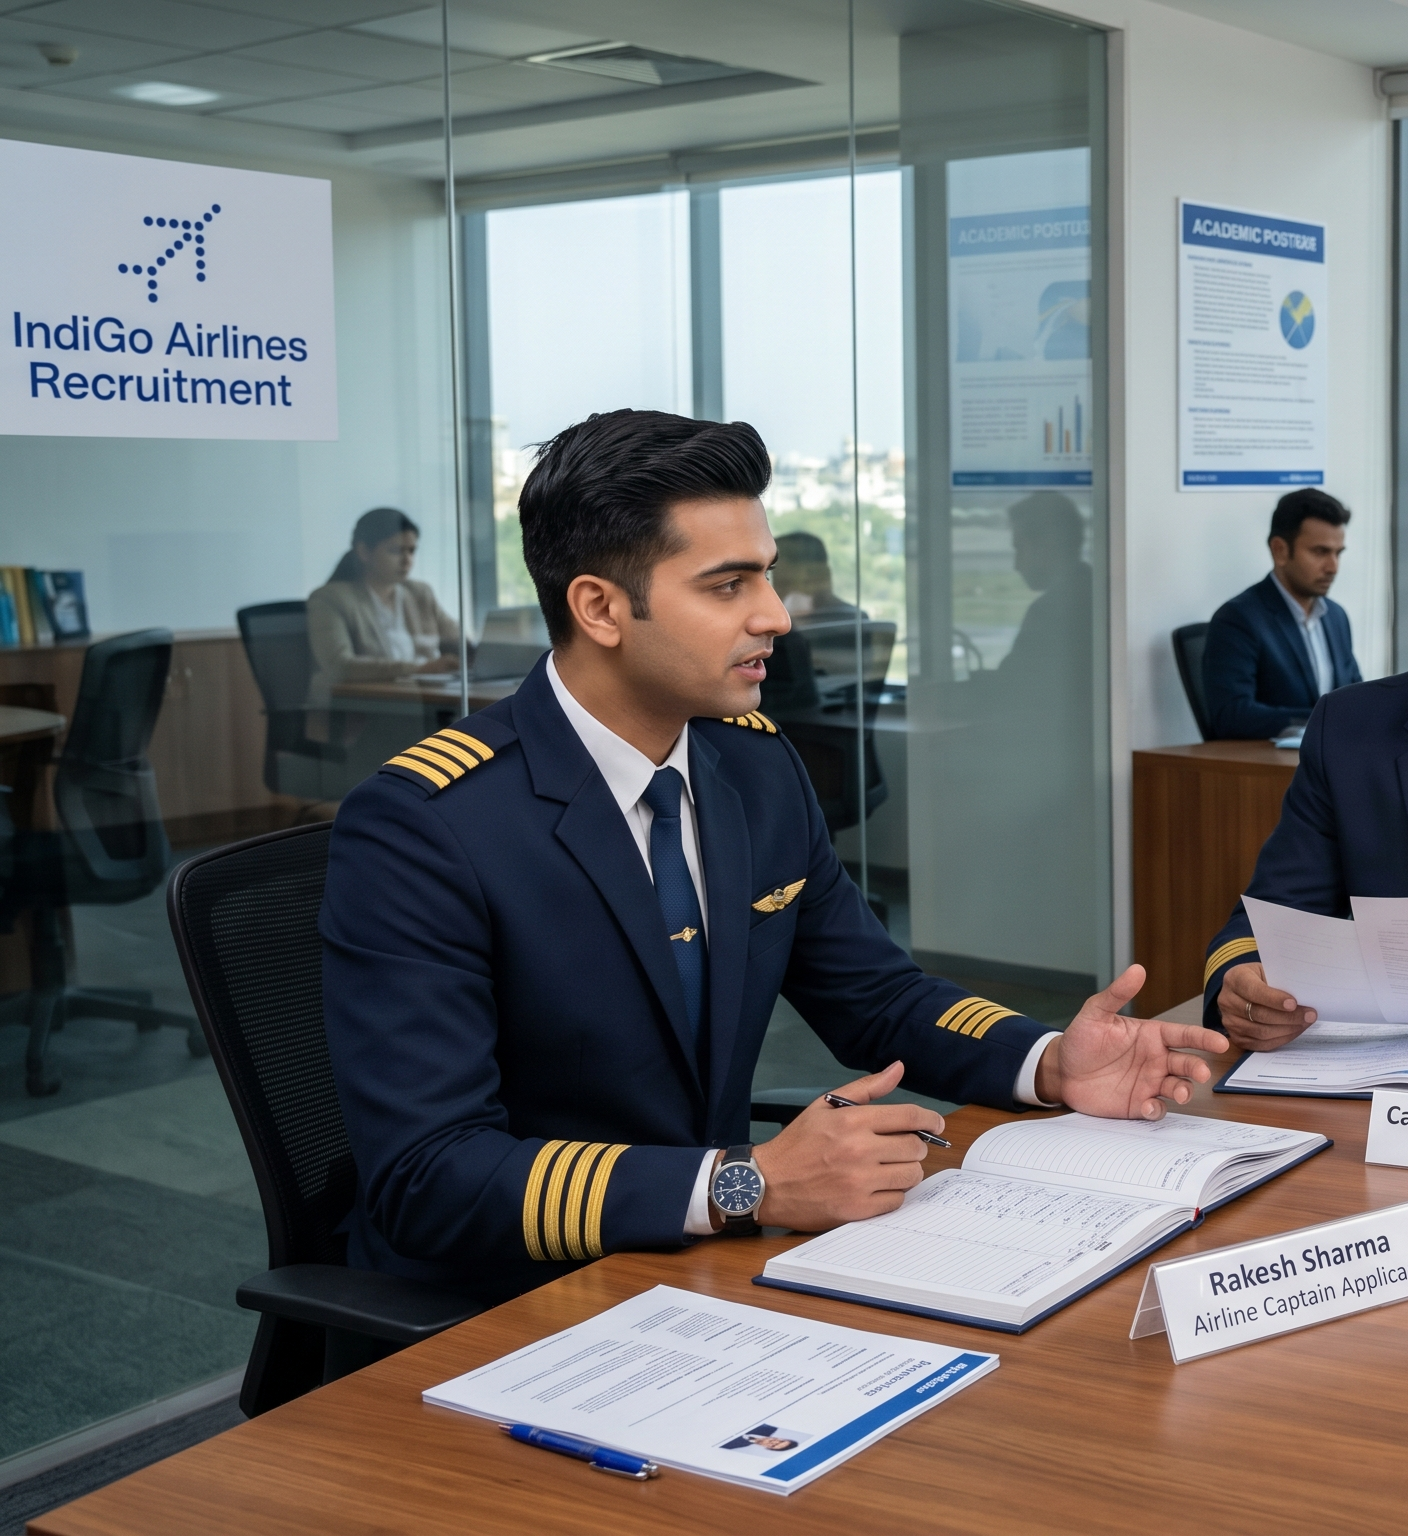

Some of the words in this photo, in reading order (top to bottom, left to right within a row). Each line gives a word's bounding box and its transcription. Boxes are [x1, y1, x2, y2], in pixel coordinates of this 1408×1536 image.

[958, 225, 1031, 245] ACADEMIC
[1192, 218, 1262, 243] ACADEMIC
[13, 311, 154, 354] IndiGo
[165, 321, 309, 362] Airlines
[29, 361, 293, 407] Recruitment
[1209, 1254, 1297, 1296] Rakesh
[1302, 1234, 1391, 1273] Sharma
[1194, 1307, 1258, 1336] Airline
[1263, 1284, 1336, 1316] Captain
